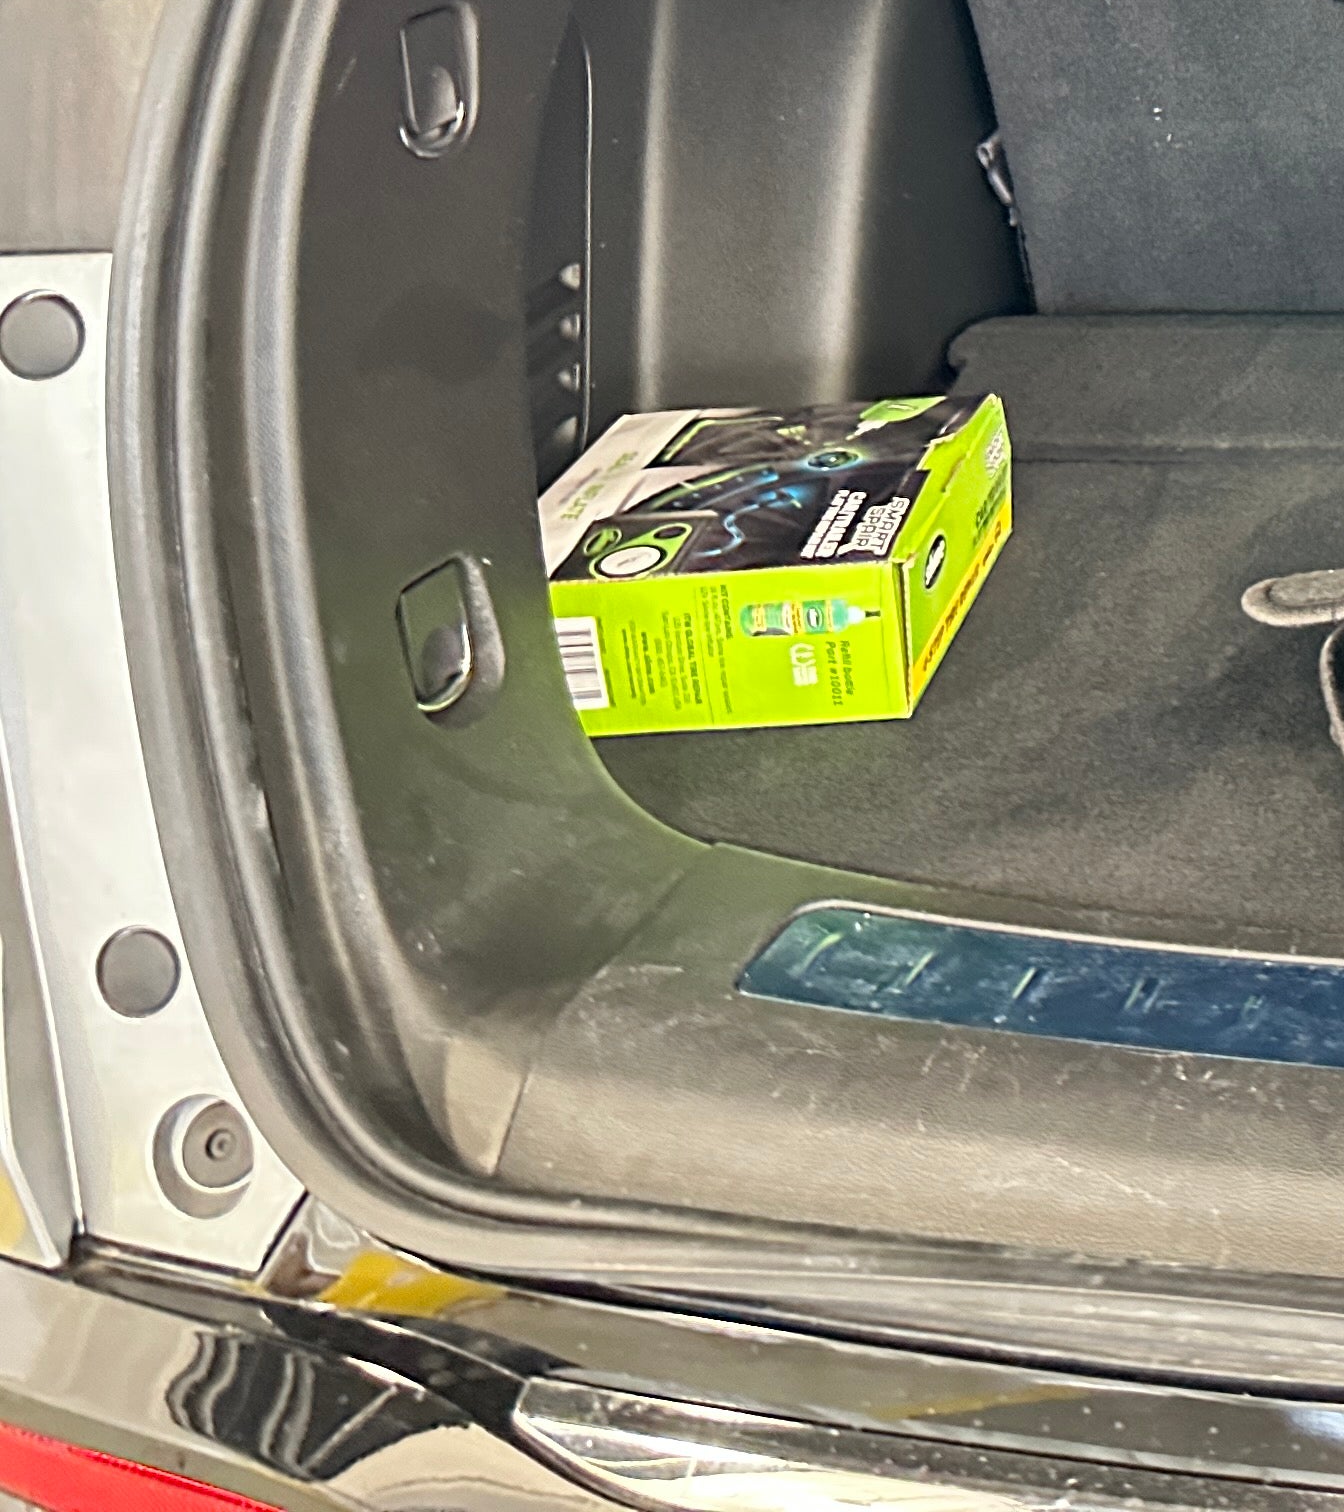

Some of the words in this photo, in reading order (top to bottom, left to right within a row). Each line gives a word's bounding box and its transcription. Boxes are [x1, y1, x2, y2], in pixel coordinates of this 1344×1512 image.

[856, 507, 885, 548] SPAIR
[870, 498, 906, 551] SMART
[826, 640, 837, 665] Part
[829, 667, 844, 706] #10011
